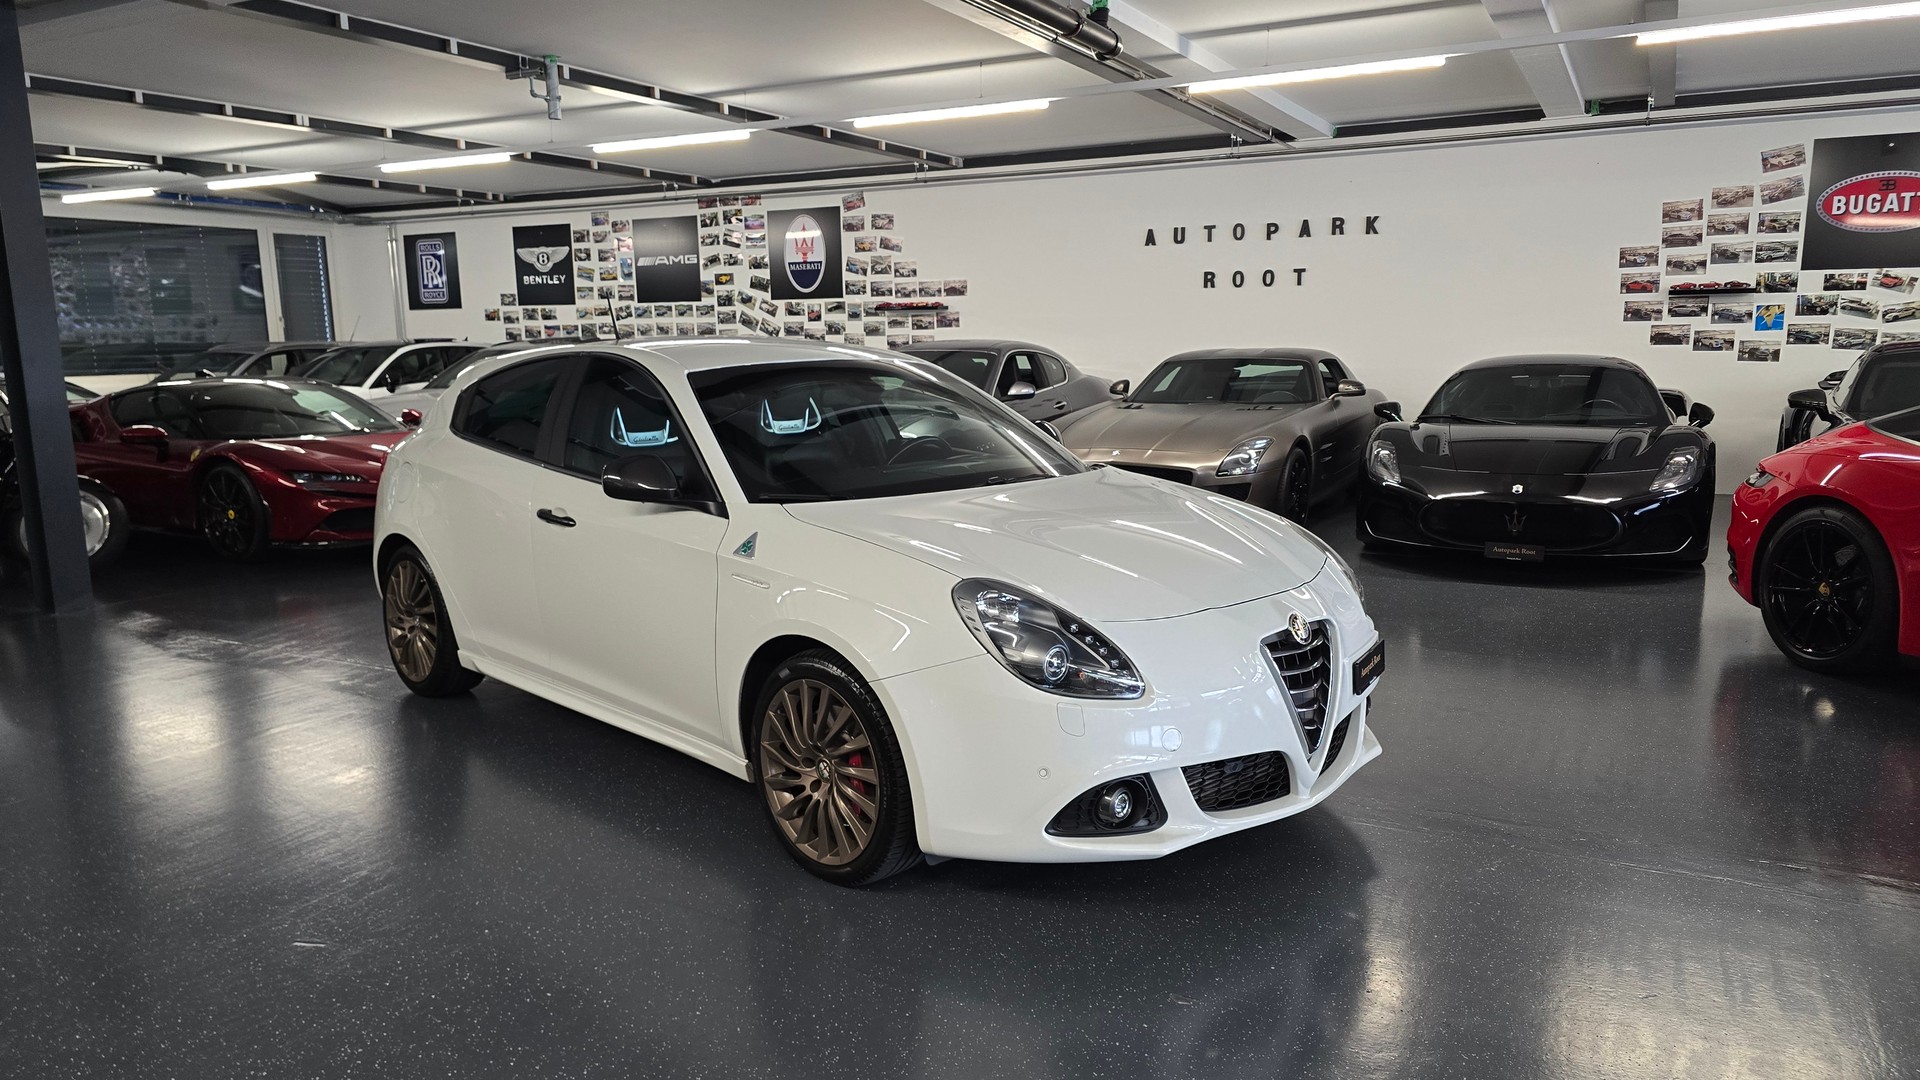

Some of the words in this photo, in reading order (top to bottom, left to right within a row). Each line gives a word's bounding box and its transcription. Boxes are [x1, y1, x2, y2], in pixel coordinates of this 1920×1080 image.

[1831, 191, 1920, 215] BUGAT
[1144, 215, 1380, 247] AUTOPARK
[655, 254, 698, 266] AMG
[790, 262, 821, 271] MASERATI
[523, 274, 566, 285] BENTLEY
[1203, 267, 1307, 289] ROOT
[424, 291, 444, 299] ROYCE
[1493, 546, 1520, 555] Autopark
